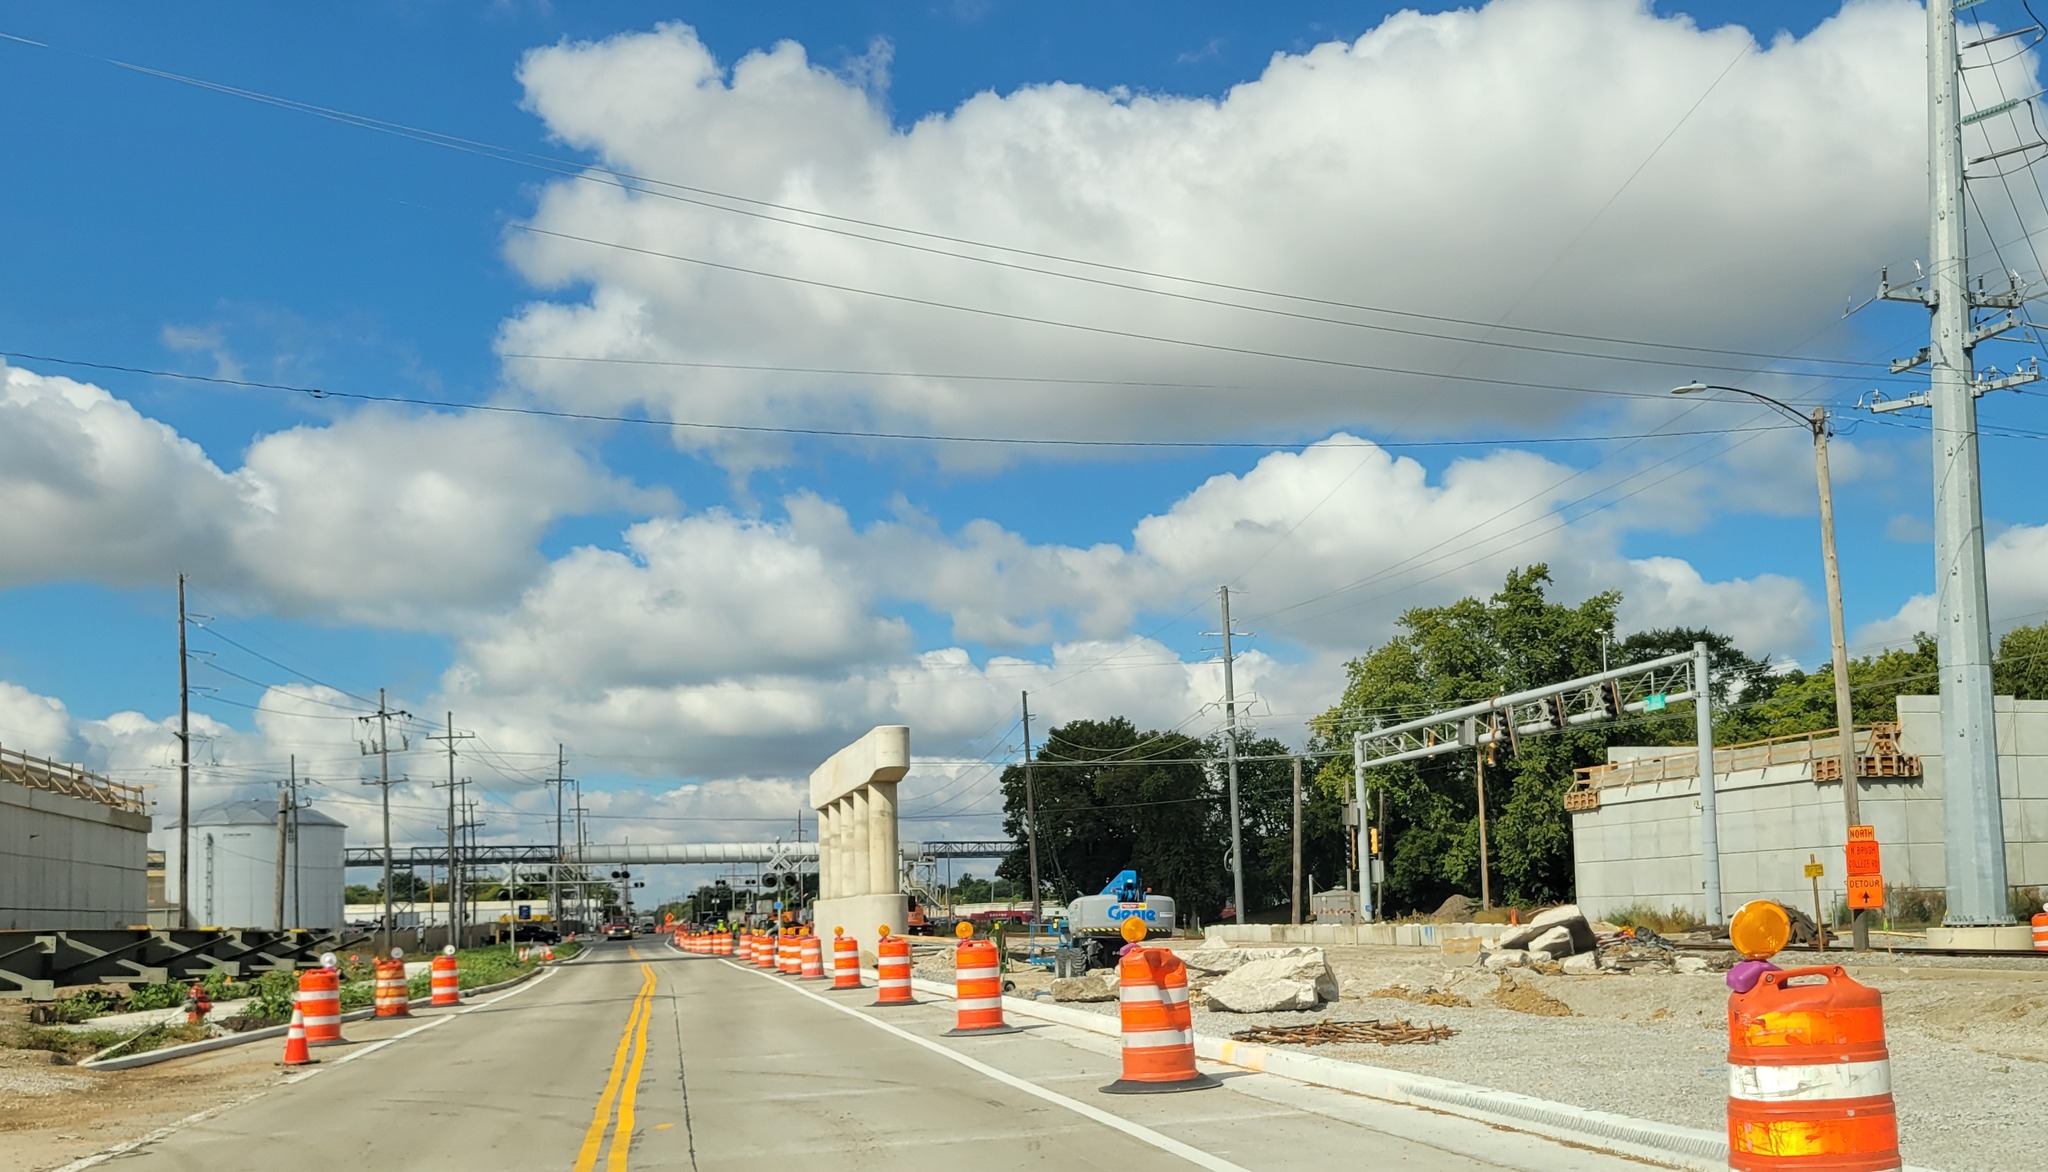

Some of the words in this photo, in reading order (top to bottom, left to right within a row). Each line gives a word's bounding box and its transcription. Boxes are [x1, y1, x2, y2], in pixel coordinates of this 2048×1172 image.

[1850, 829, 1873, 838] NORTH
[1851, 847, 1855, 855] N
[1857, 846, 1875, 855] BRUSH
[1849, 880, 1880, 888] DETOUR
[1107, 905, 1156, 921] Genie
